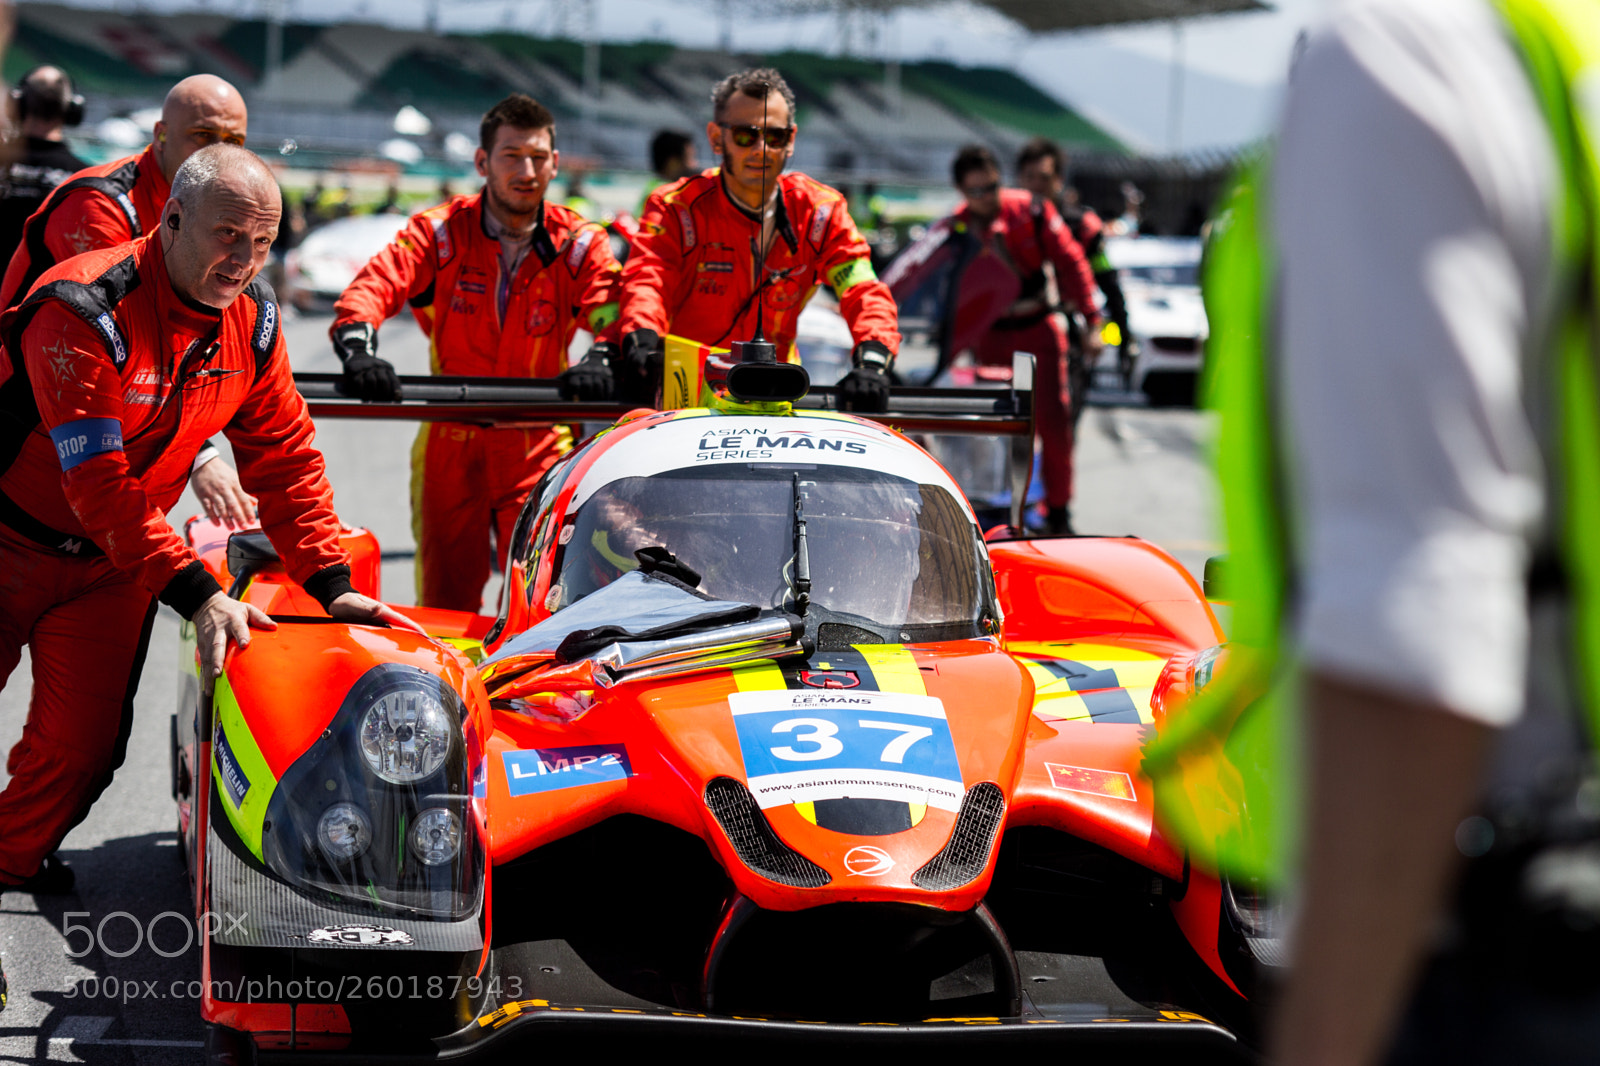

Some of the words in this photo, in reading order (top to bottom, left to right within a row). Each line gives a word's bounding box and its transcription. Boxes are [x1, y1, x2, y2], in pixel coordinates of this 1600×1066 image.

[258, 302, 275, 351] sparco
[98, 314, 127, 363] sparco
[132, 373, 147, 384] LE
[101, 438, 112, 446] LE
[702, 428, 768, 437] ASIAN
[58, 434, 88, 460] STOP
[695, 449, 773, 462] SERIES
[698, 436, 743, 451] LE
[755, 436, 867, 455] MANS
[819, 697, 872, 705] MANS
[769, 717, 933, 764] 37
[217, 742, 247, 798] MICHELIN
[511, 752, 624, 780] LMP2
[759, 778, 957, 799] www.asianlemansseries.com
